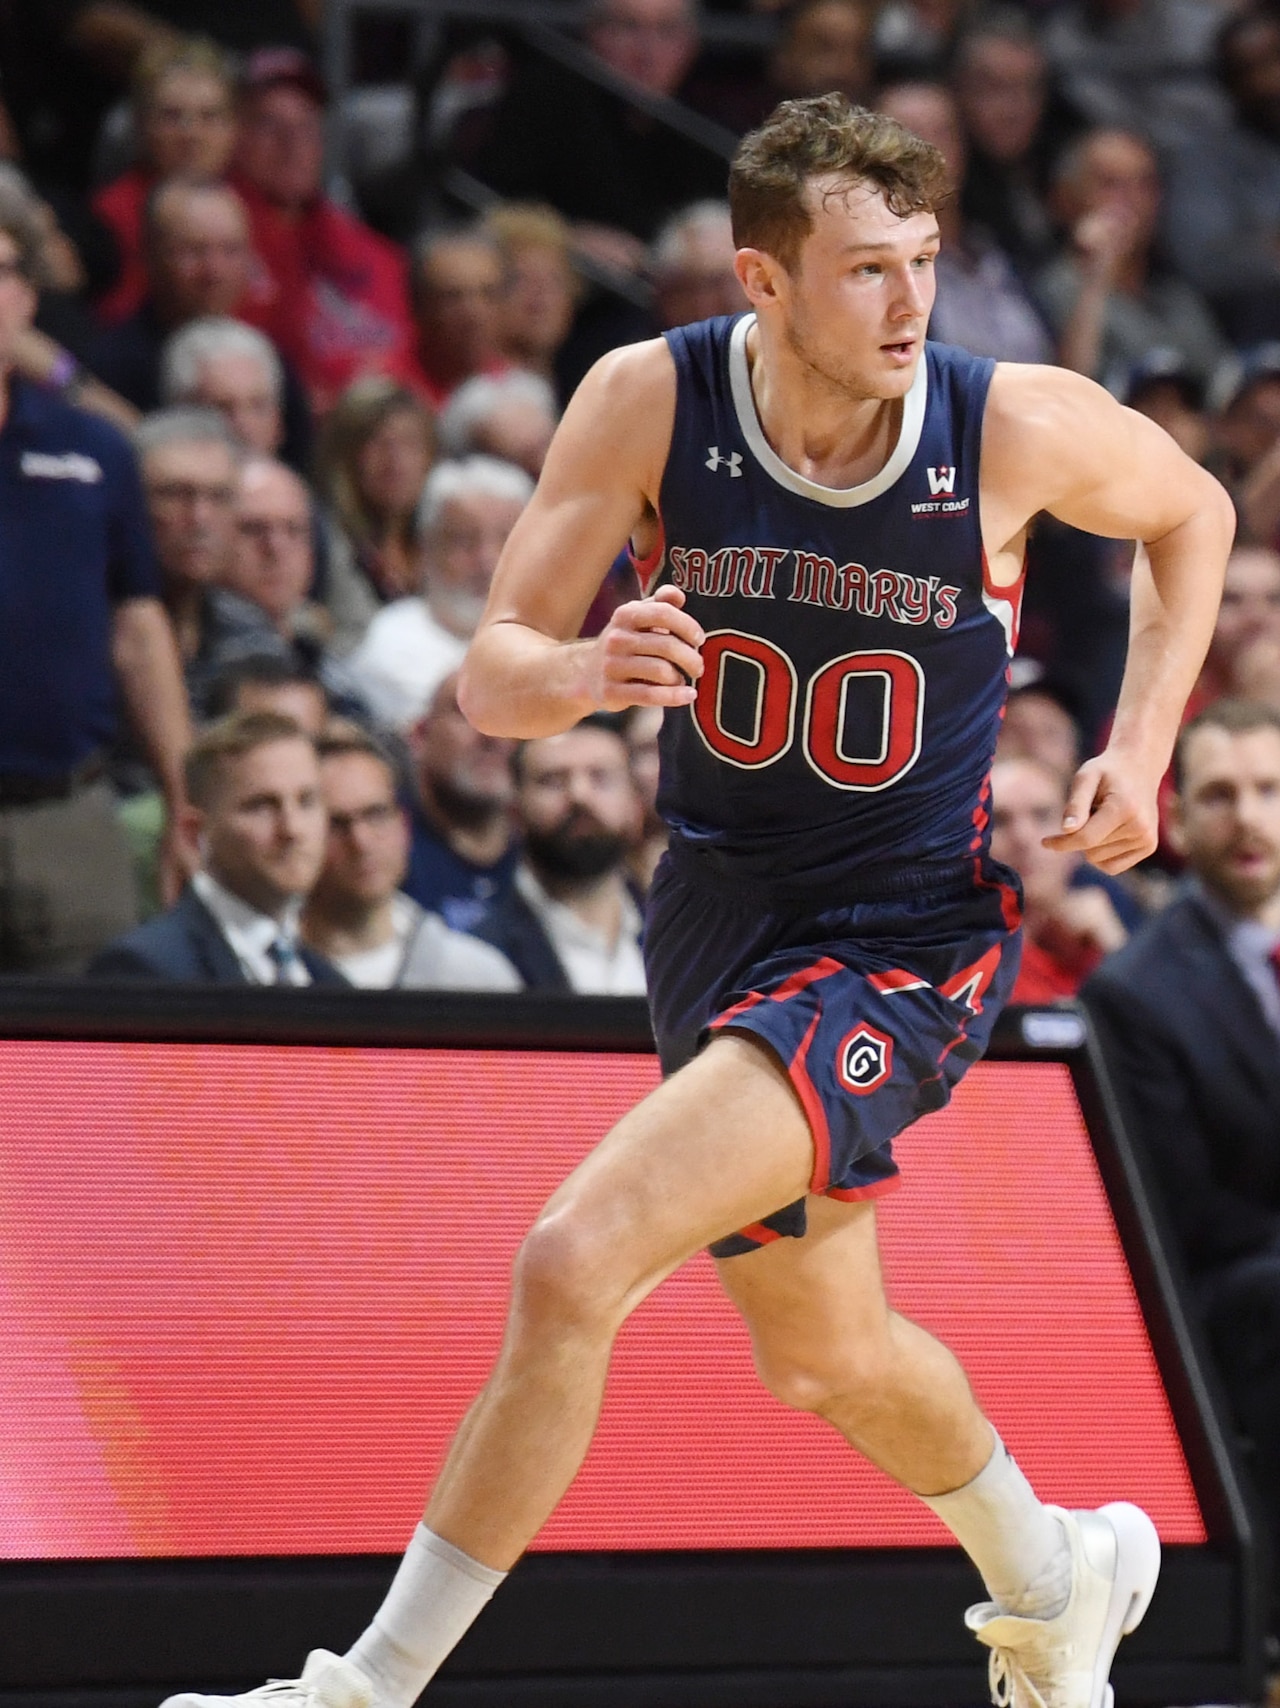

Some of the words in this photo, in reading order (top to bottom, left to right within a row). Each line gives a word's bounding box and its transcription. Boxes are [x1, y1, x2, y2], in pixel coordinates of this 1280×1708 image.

[911, 502, 940, 513] WEST
[941, 497, 970, 512] COAST
[670, 546, 789, 599] SAINT
[788, 549, 961, 629] MARY'S
[690, 628, 925, 792] 00
[850, 1046, 878, 1077] G
